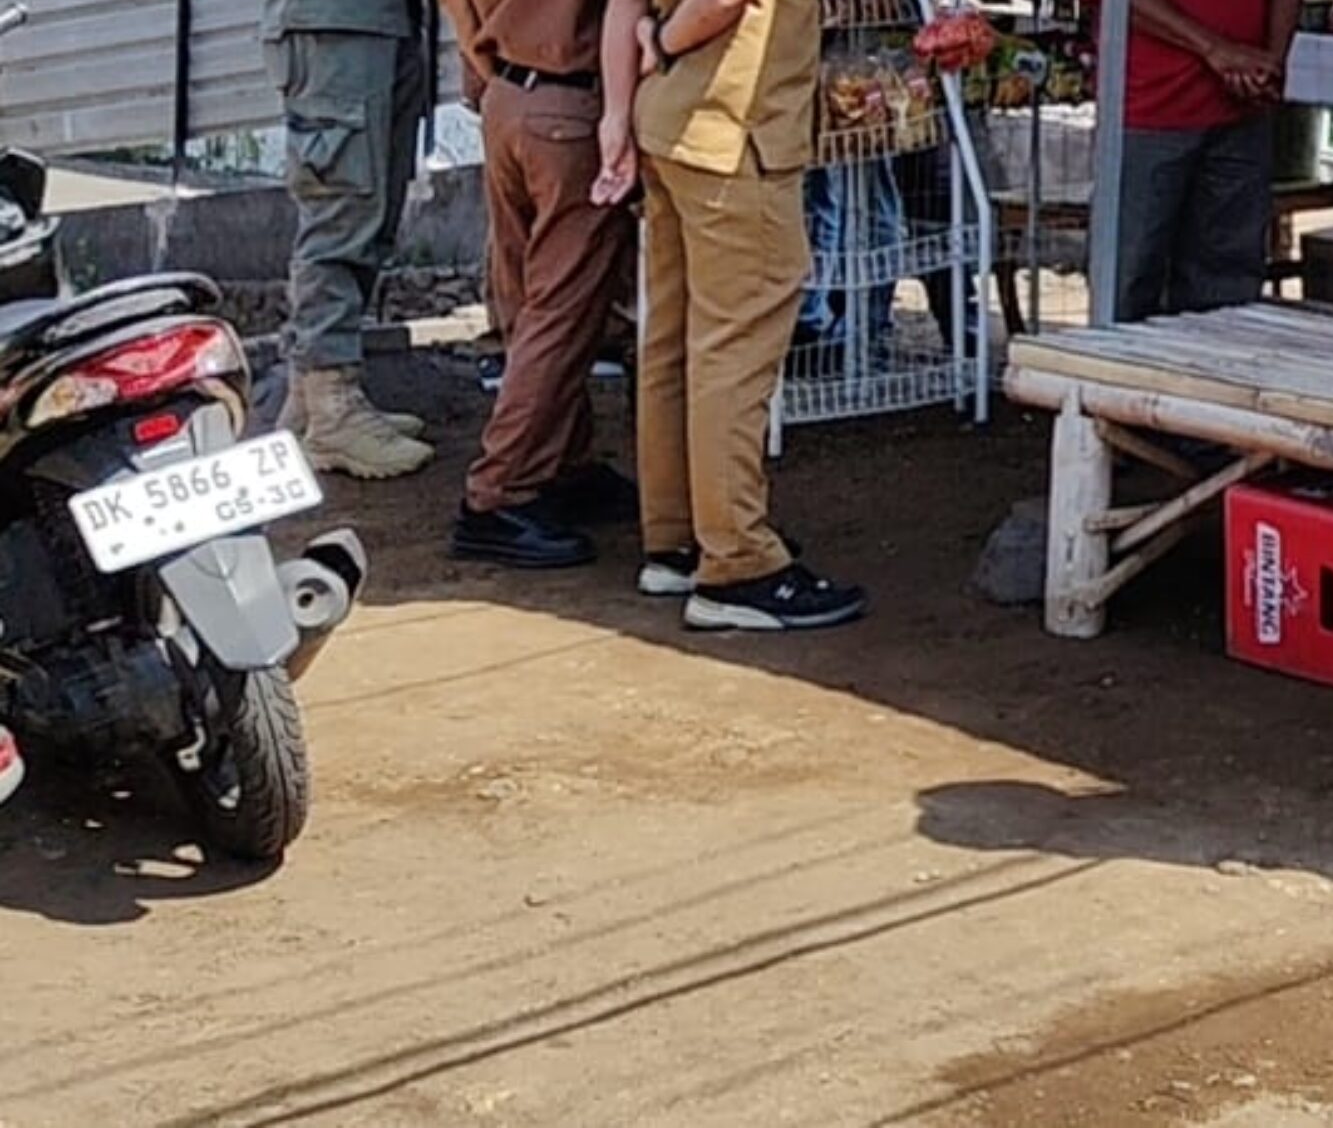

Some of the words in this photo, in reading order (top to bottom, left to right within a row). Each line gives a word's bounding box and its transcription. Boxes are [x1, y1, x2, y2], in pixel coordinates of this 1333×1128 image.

[82, 490, 133, 531] DK
[145, 460, 231, 509] 5866
[249, 441, 288, 477] ZP
